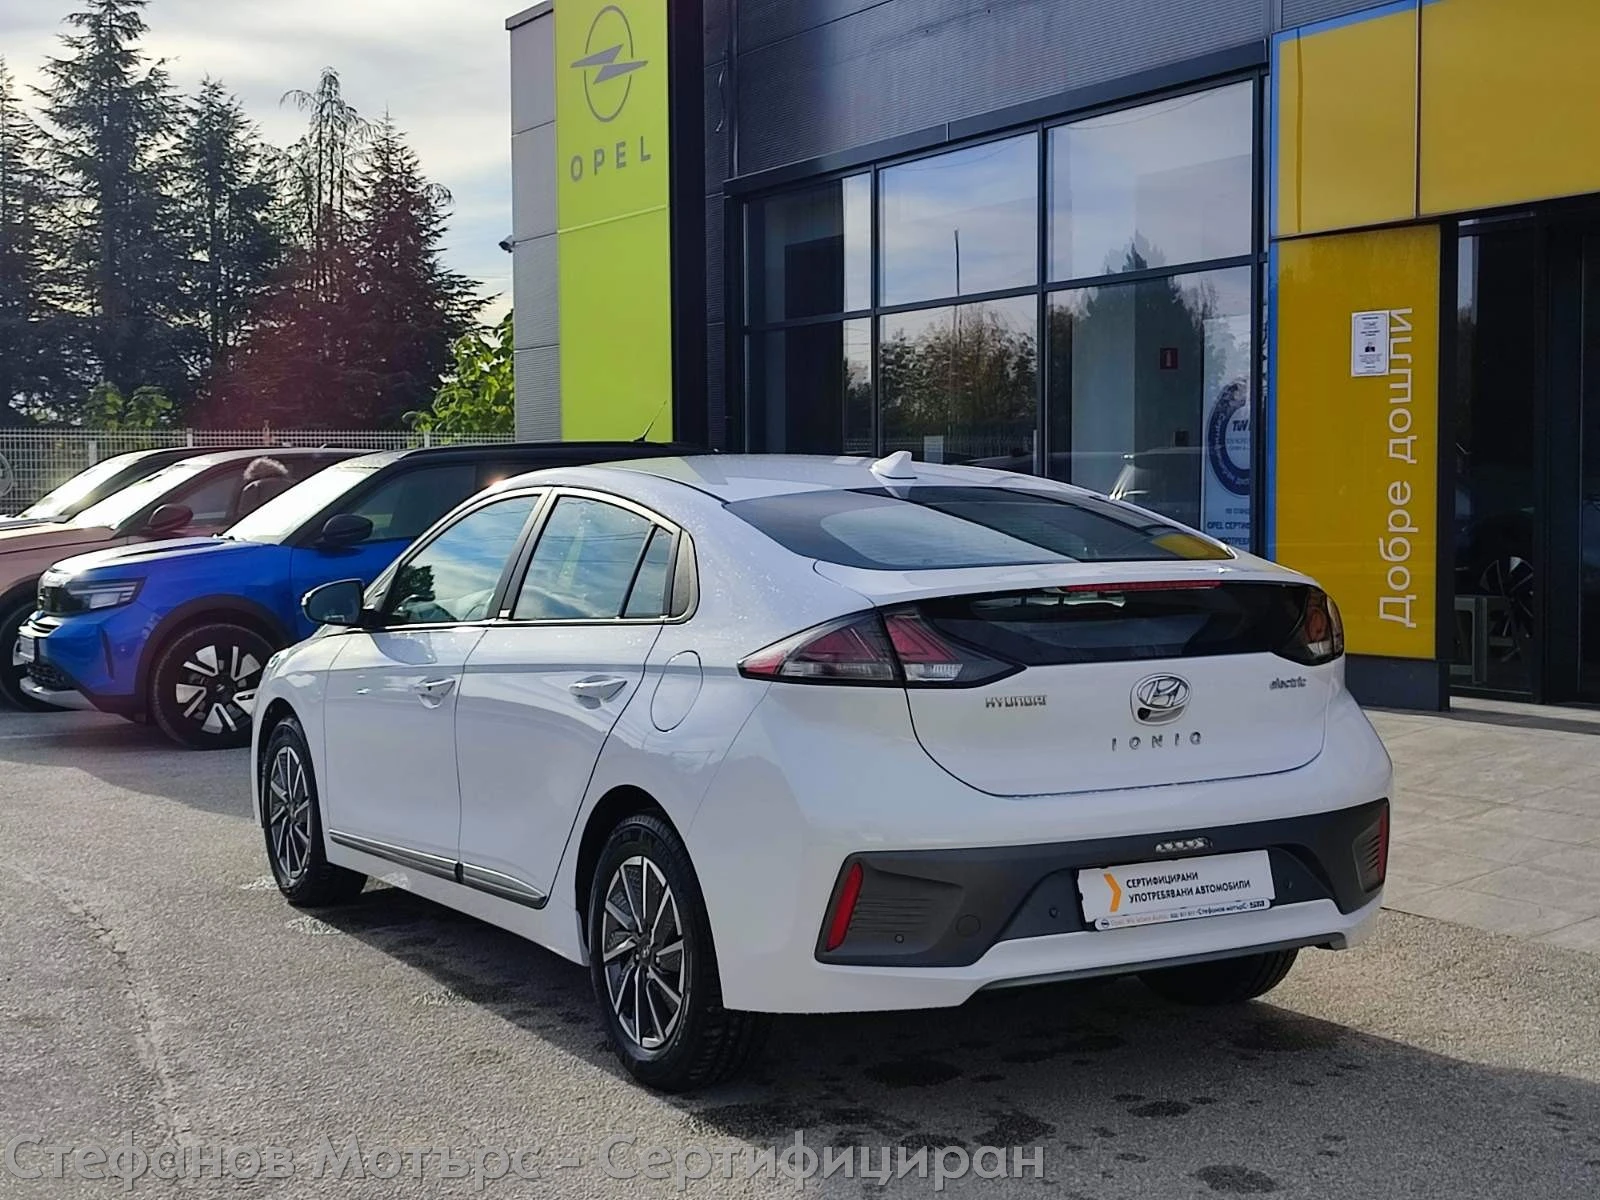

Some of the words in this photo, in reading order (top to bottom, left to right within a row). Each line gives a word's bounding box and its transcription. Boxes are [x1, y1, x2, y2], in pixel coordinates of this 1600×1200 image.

[570, 135, 652, 183] OPEL
[1388, 307, 1418, 465] дошли
[1378, 480, 1419, 629] Добре
[1269, 675, 1307, 691] electric
[984, 695, 1047, 708] HYUNDAI
[1111, 731, 1202, 752] IONIQ
[1126, 871, 1199, 889] СЕРТИФИЦИРАНИ
[1128, 887, 1194, 904] УПОТРЕБЯВАНИ
[1195, 879, 1251, 895] АВТОМОБИЛИ
